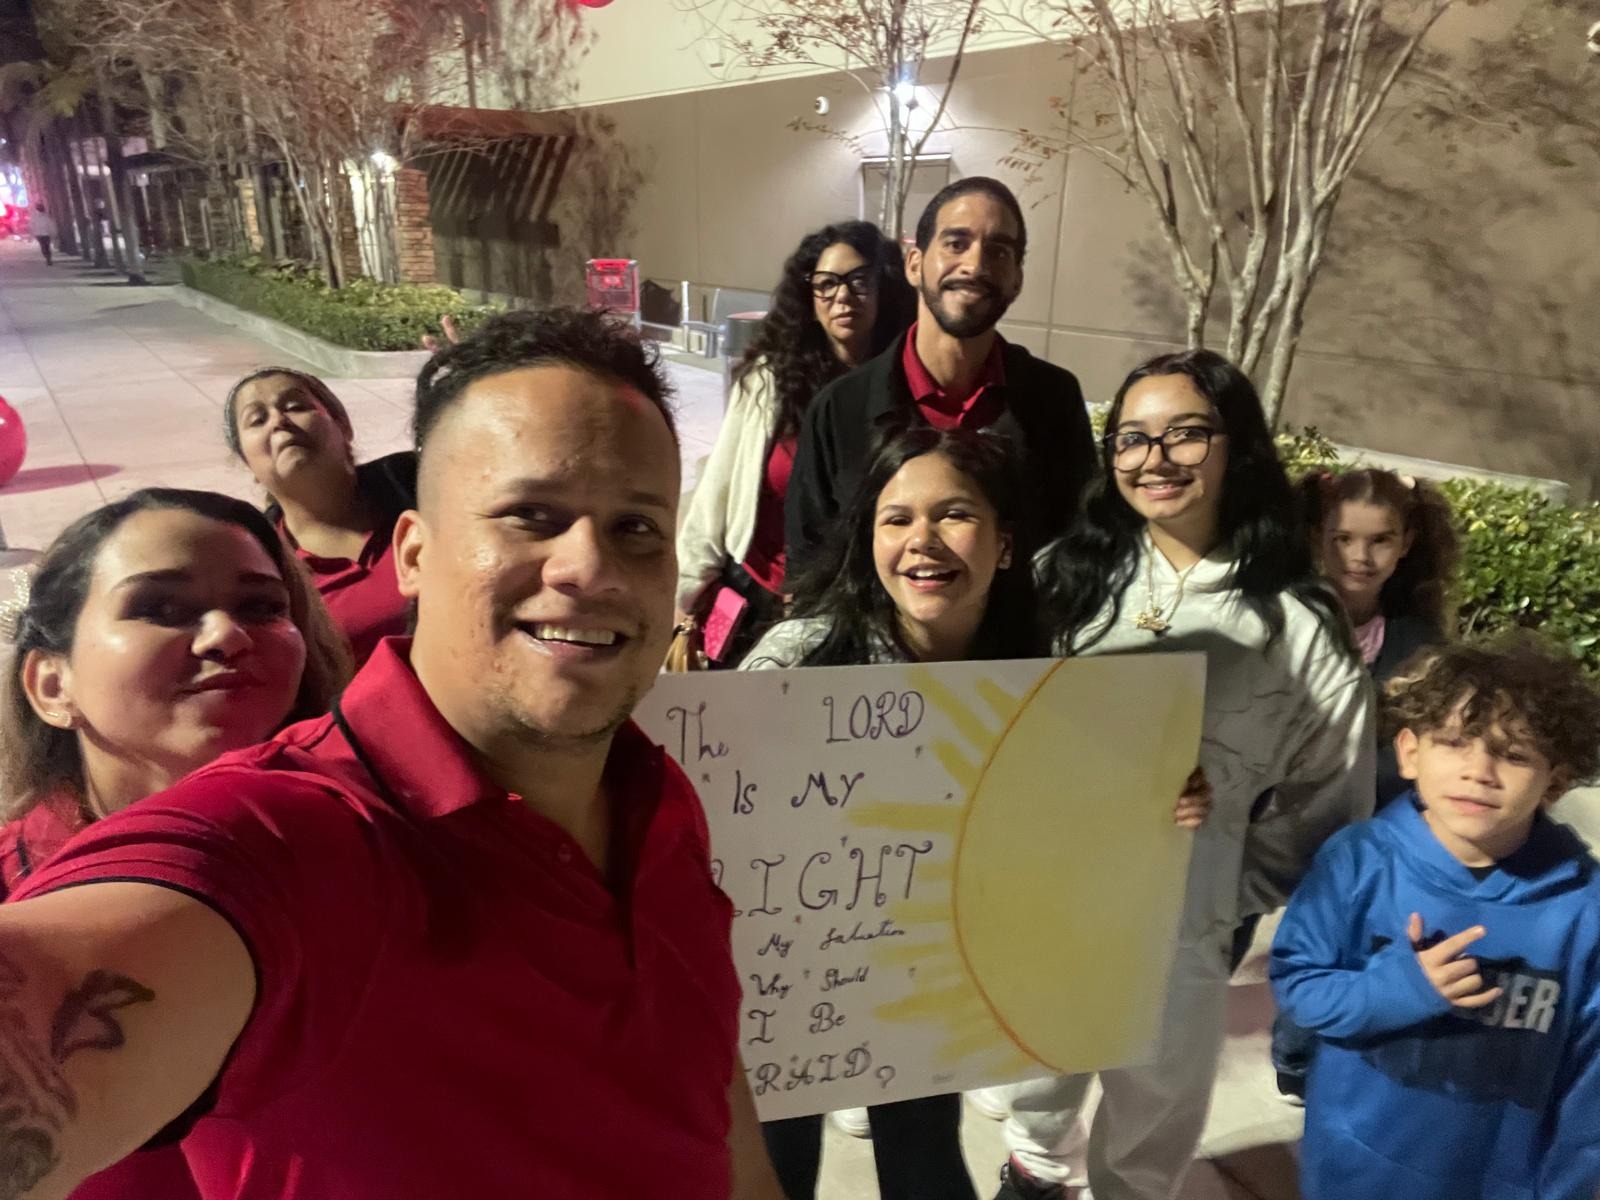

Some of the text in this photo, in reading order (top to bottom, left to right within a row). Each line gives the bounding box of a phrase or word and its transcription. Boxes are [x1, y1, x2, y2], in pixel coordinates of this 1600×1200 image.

[666, 690, 925, 765] The LORD
[757, 933, 795, 958] My
[750, 966, 870, 999] Why Should
[748, 1001, 846, 1046] I Be
[745, 1045, 897, 1096] RAID?
